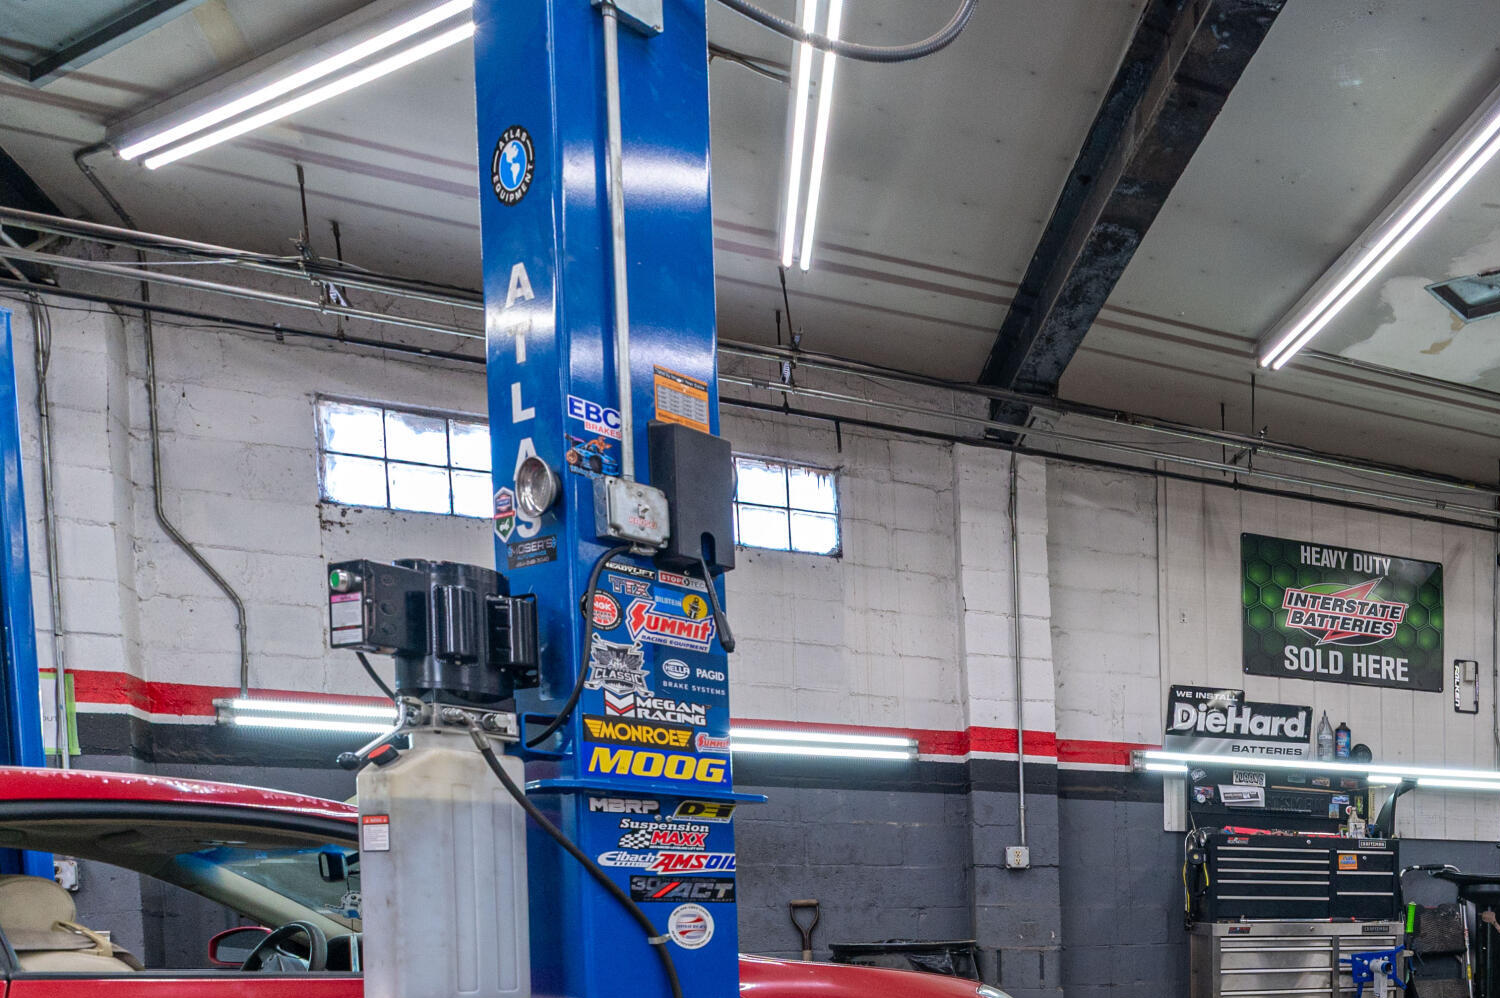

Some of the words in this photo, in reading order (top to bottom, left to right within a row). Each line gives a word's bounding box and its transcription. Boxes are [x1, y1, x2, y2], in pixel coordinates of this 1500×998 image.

[498, 128, 527, 150] ATLAS
[493, 163, 534, 202] EQUIPMENT
[569, 397, 621, 430] EBC
[585, 421, 622, 439] BRAKES
[1300, 545, 1347, 570] HEAVY
[1353, 553, 1391, 576] DUTY
[1286, 592, 1402, 619] INTERSTATE
[1291, 610, 1394, 636] BATTERIES
[641, 635, 667, 645] RACING
[669, 639, 709, 653] EQUIPMENT
[664, 662, 690, 676] HELLA
[696, 668, 725, 682] PAGID
[1284, 646, 1343, 675] SOLD
[1352, 653, 1409, 682] HERE
[594, 668, 643, 686] CLASSIC
[663, 681, 690, 691] BRAKE
[692, 685, 726, 696] SYSTEMS
[1176, 690, 1192, 700] WE
[1195, 691, 1239, 702] INSTALL
[635, 698, 706, 715] MEGAN
[641, 708, 706, 726] RACING
[1173, 702, 1306, 738] DieHard
[599, 719, 682, 746] MONROE
[1231, 744, 1303, 757] BATTERIES
[588, 746, 727, 783] MOOG
[589, 797, 659, 814] MBRP
[620, 818, 709, 834] Suspension
[651, 831, 708, 847] MAXX
[598, 851, 656, 866] Eibach
[653, 853, 736, 872] AMSOIL
